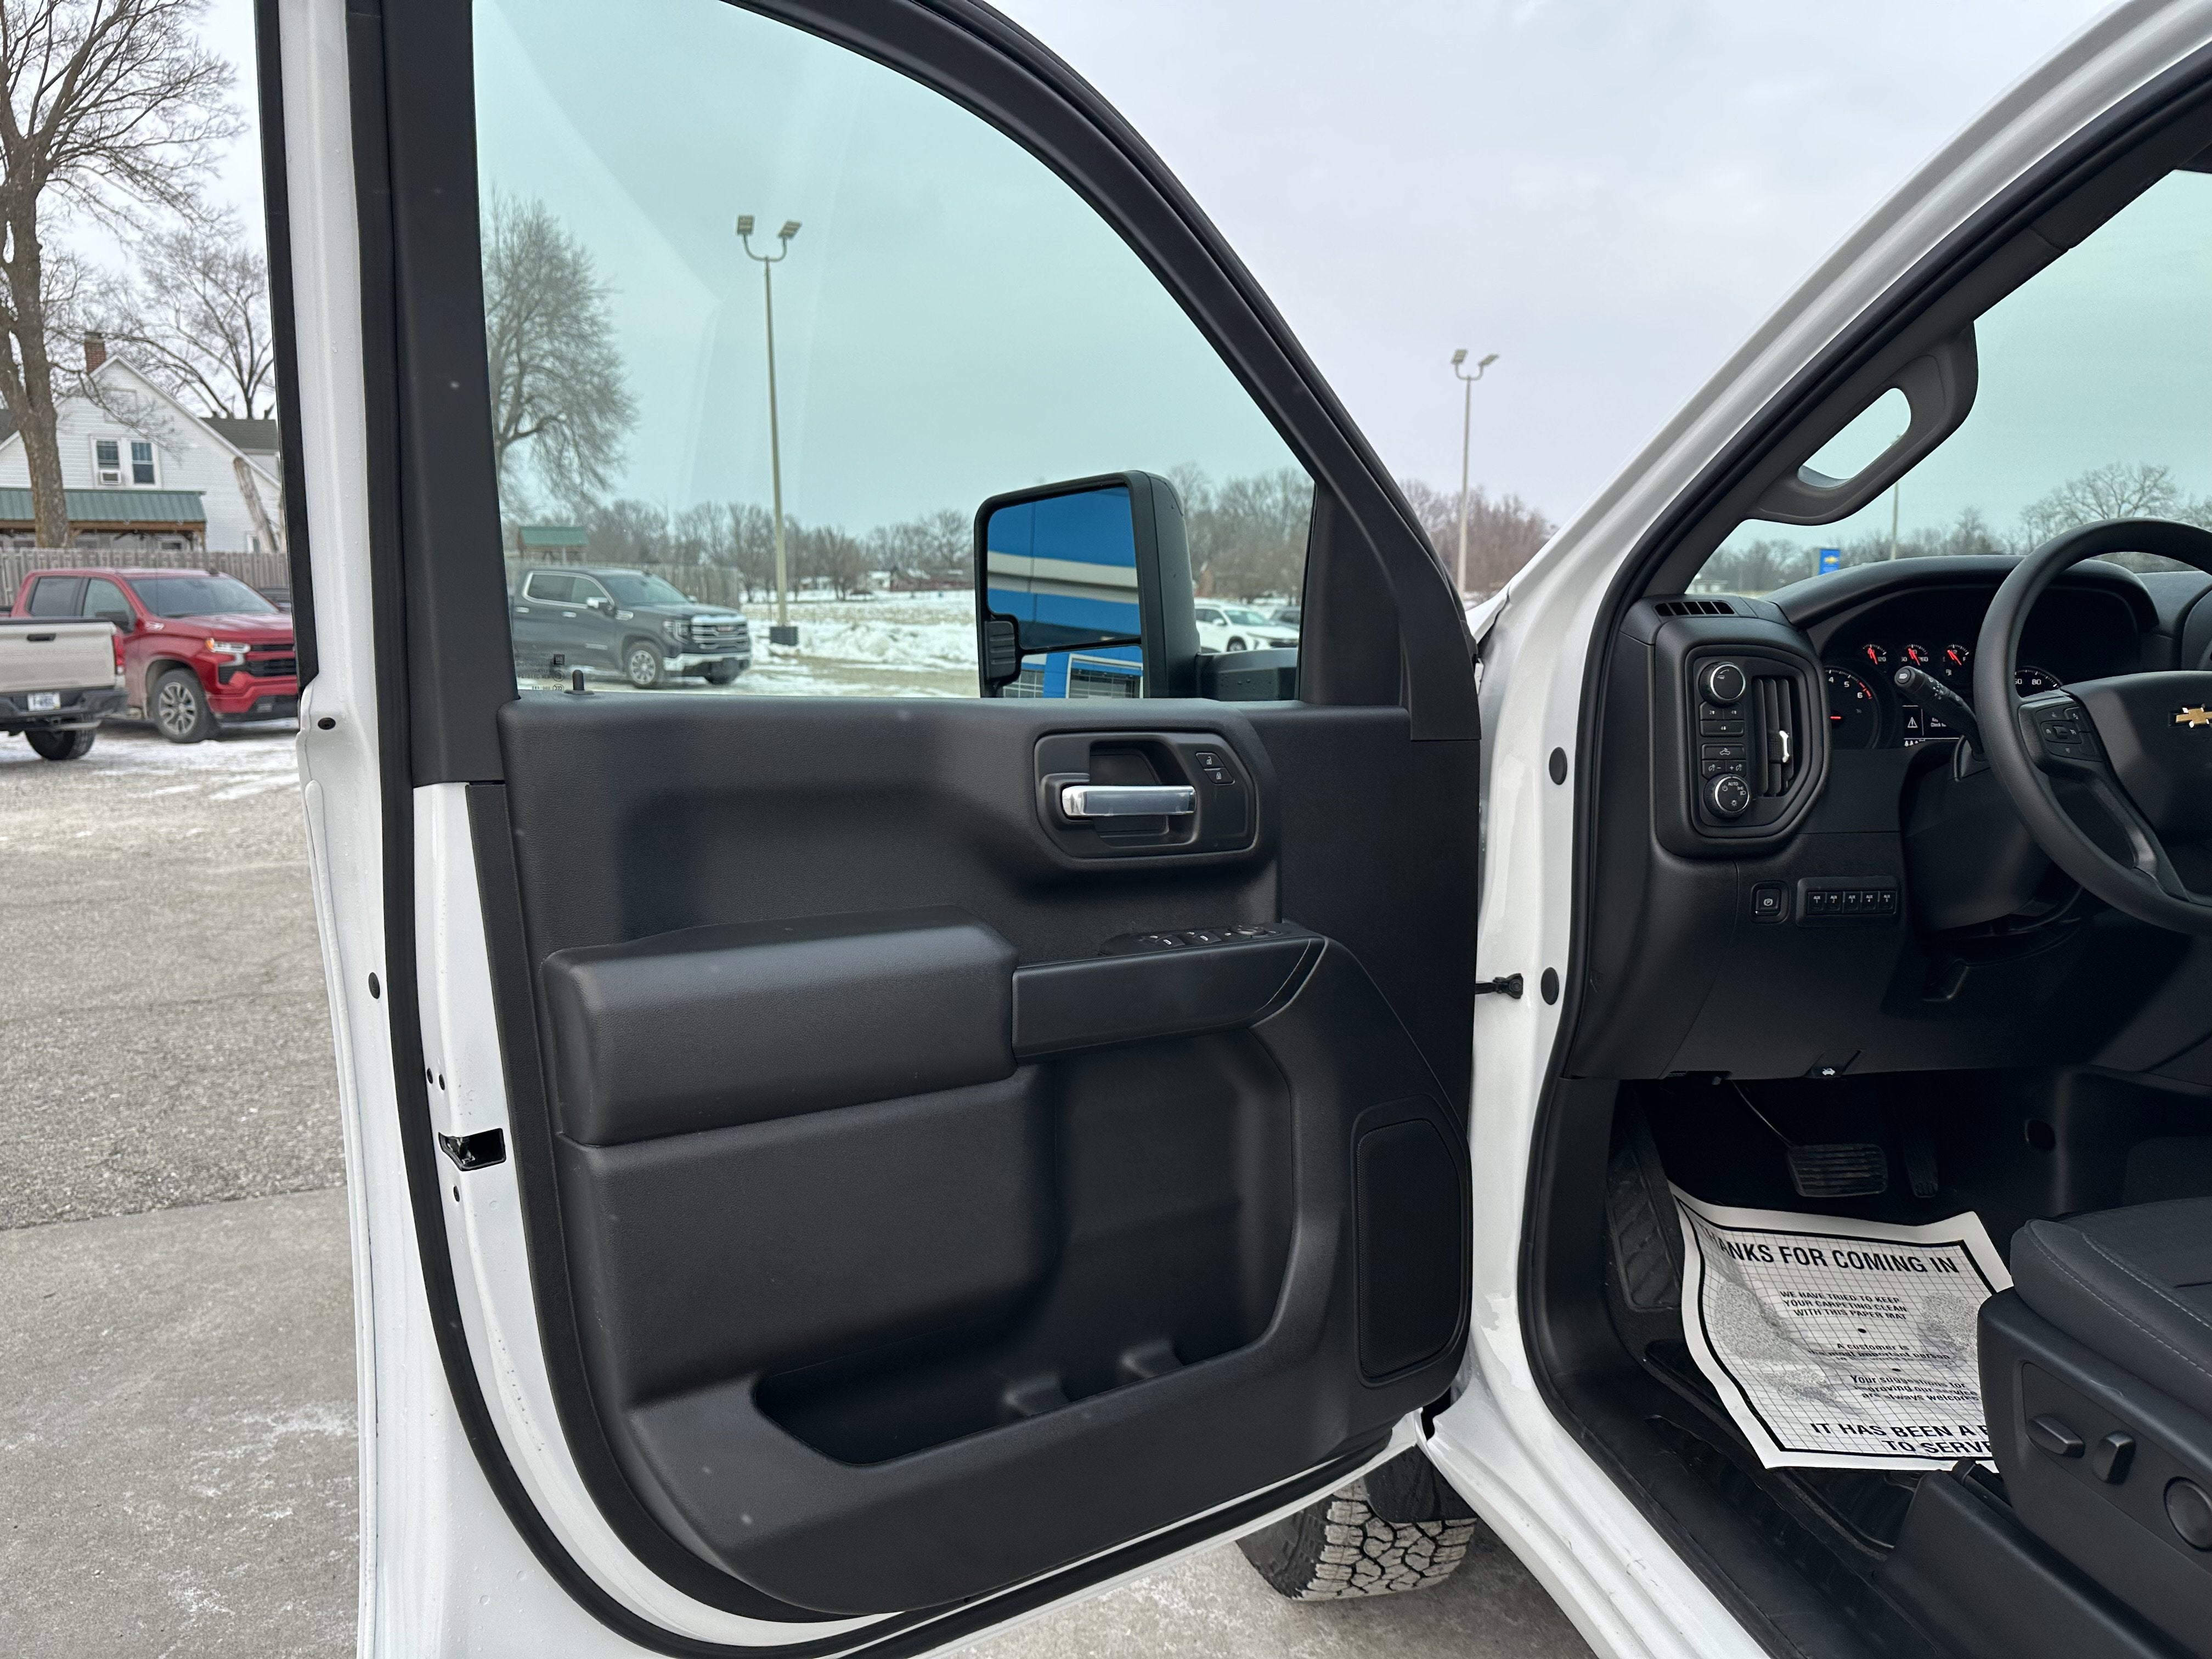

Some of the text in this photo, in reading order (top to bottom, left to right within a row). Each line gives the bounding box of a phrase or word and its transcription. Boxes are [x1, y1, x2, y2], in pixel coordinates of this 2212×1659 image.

[1779, 1246, 1828, 1267] FOR
[1832, 1249, 1929, 1273] COMING
[1932, 1256, 1960, 1273] IN
[1826, 1293, 1857, 1301] TRIED
[1815, 1300, 1872, 1310] CARPETING
[1875, 1304, 1908, 1312] CLEAN
[1849, 1310, 1884, 1318] PAPER
[1850, 1375, 1877, 1384] Your
[1879, 1377, 1948, 1387] suggestions
[1810, 1423, 1831, 1434] IT
[1838, 1423, 1887, 1436] HAS
[1889, 1425, 1954, 1437] BEEN
[1958, 1425, 1977, 1436] A
[1882, 1440, 1917, 1452] TO
